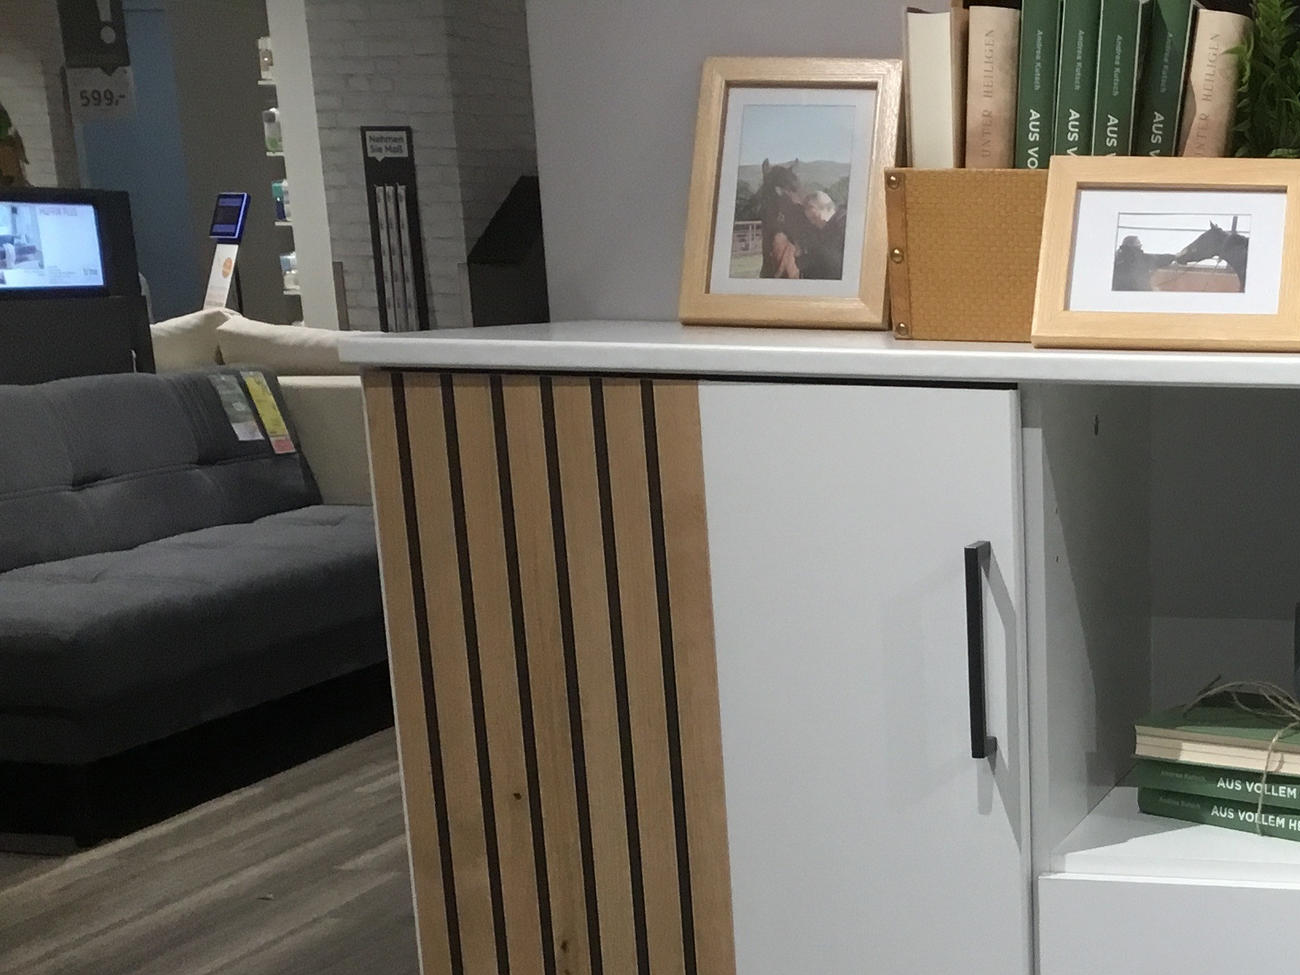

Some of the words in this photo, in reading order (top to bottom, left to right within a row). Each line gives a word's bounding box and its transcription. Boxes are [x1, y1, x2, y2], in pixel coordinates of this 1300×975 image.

[80, 88, 126, 107] 599,-
[1028, 109, 1041, 142] AUS
[1067, 108, 1081, 142] AUS
[1106, 114, 1119, 147] AUS
[1151, 111, 1165, 144] AUS
[1217, 777, 1242, 791] AUS
[1245, 781, 1297, 799] VOLLEM
[1210, 805, 1235, 819] AUS
[1237, 809, 1286, 829] VOLLEM
